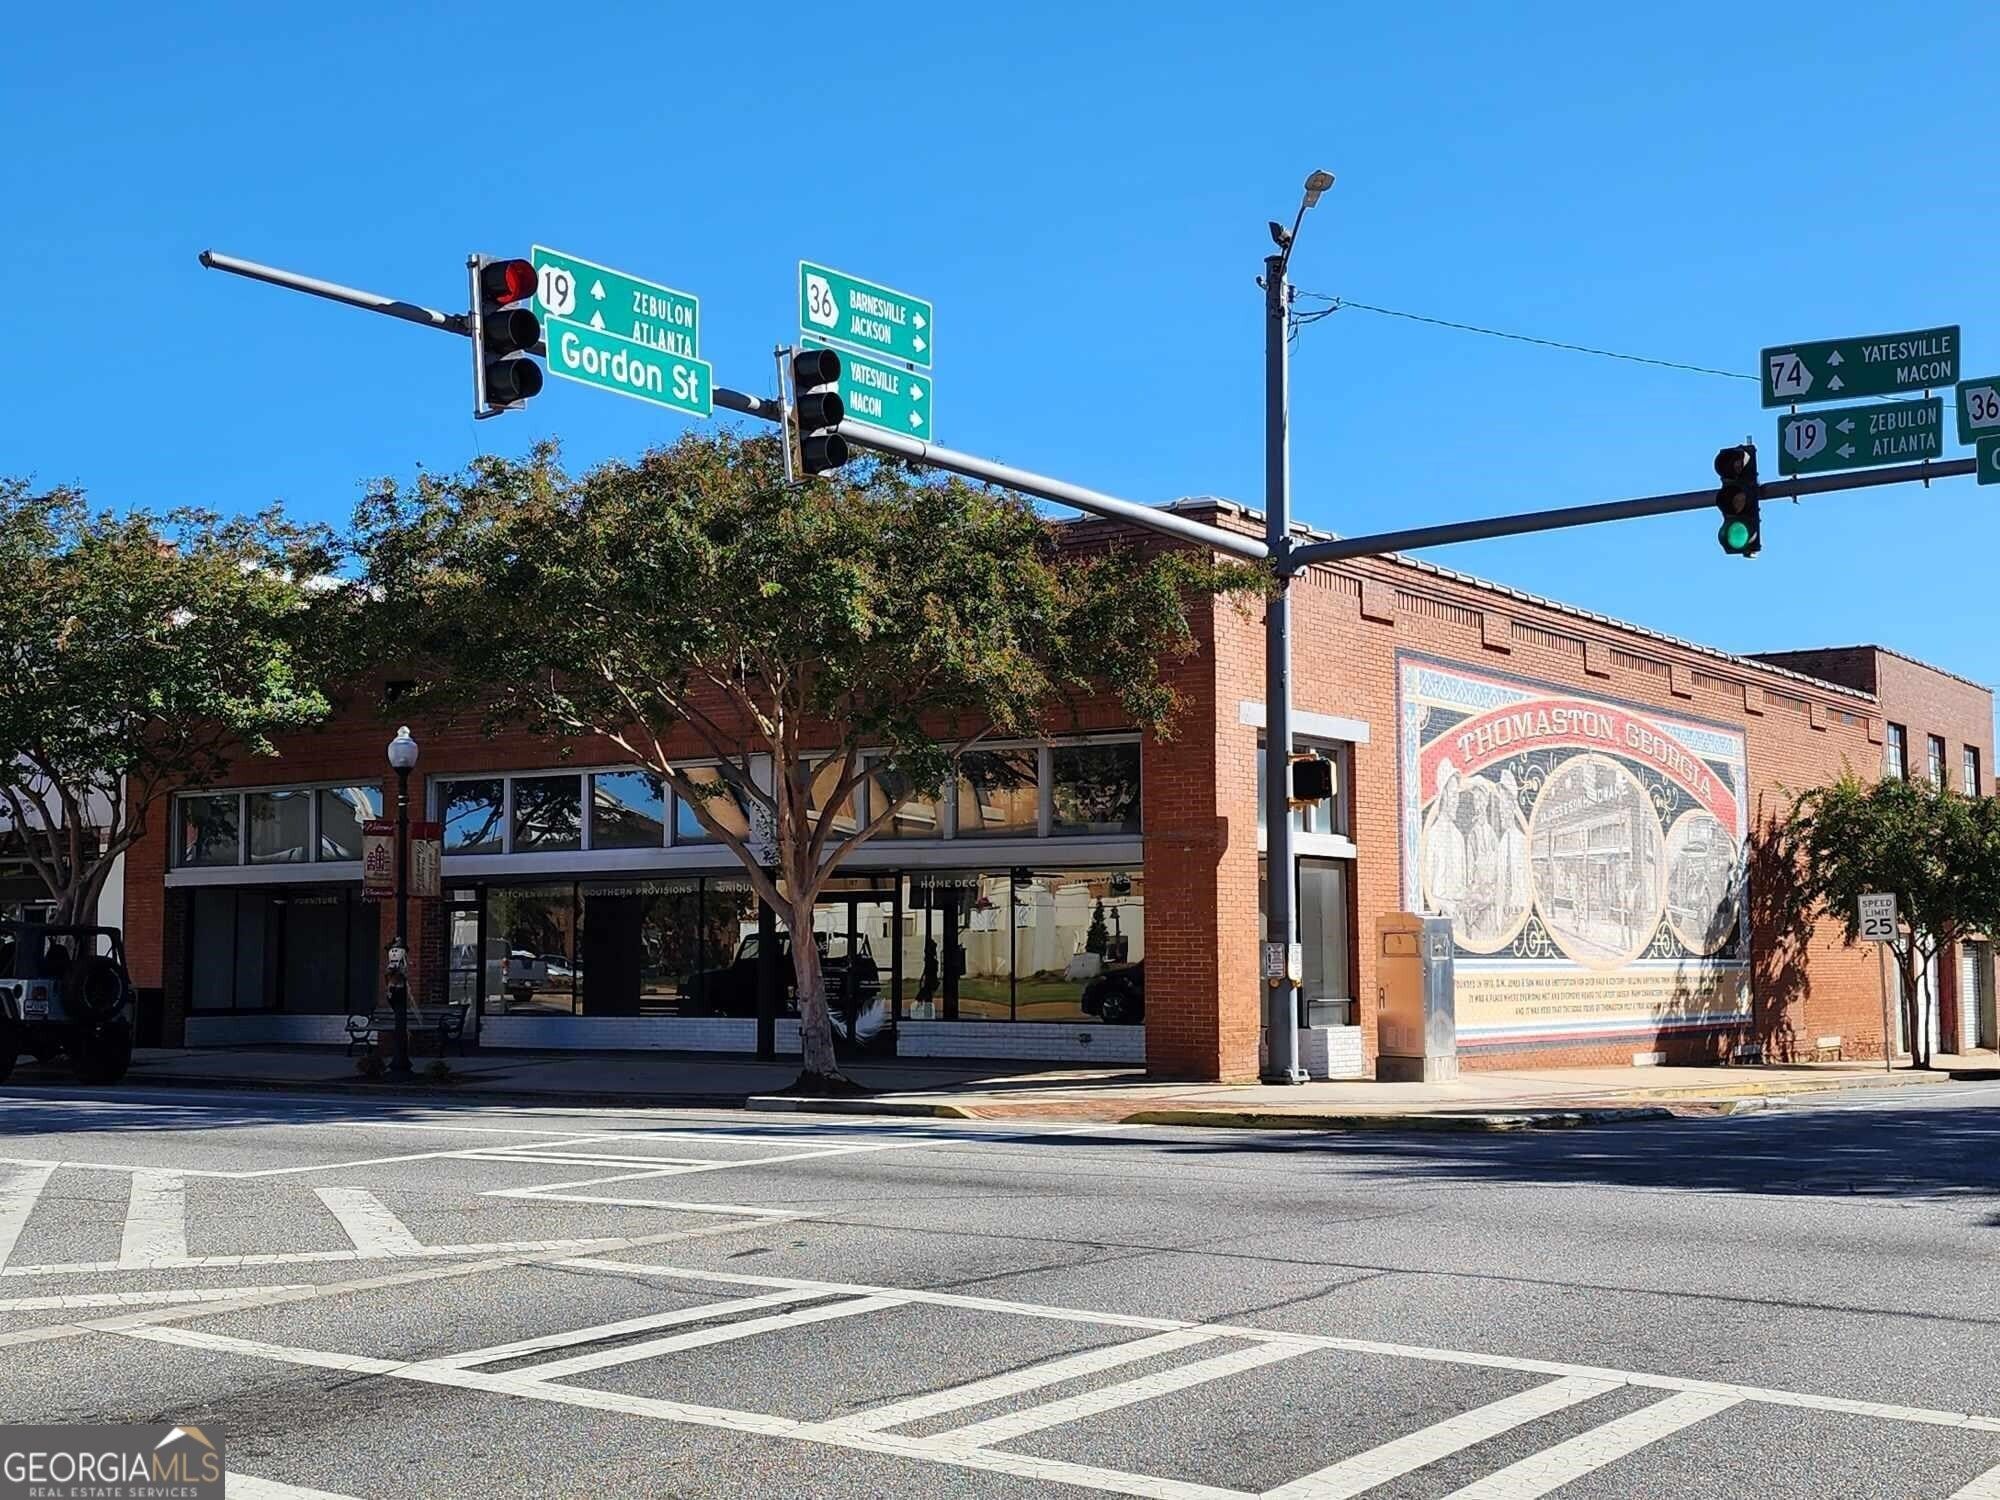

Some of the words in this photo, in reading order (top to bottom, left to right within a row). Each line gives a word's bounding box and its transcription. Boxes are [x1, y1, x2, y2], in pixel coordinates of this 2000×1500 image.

[543, 271, 569, 305] 19
[810, 283, 832, 318] 36
[632, 291, 693, 328] ZEBULON
[849, 289, 906, 326] BARNESVILLE
[632, 320, 693, 357] ATLANTA
[850, 315, 892, 345] JACKSON
[1862, 335, 1951, 363] YATESVILLE
[561, 331, 662, 393] Gordon
[673, 369, 699, 404] St
[850, 361, 900, 394] YATESVILLE
[1771, 361, 1802, 390] 74
[1896, 360, 1951, 385] MACON
[850, 389, 882, 419] MACON
[1971, 391, 1999, 421] 36
[1869, 406, 1937, 435] ZEBULON
[1794, 423, 1817, 451] 19
[1872, 432, 1936, 457] ATLANTA
[1624, 721, 1714, 802] GEORGIA
[584, 888, 633, 898] SOUTHERN
[635, 885, 693, 896] PROVISIONS
[719, 882, 755, 893] UNIQU
[920, 879, 952, 889] HOME
[1862, 899, 1893, 908] SPEED
[1865, 908, 1890, 917] LIMIT
[1864, 918, 1893, 935] 25
